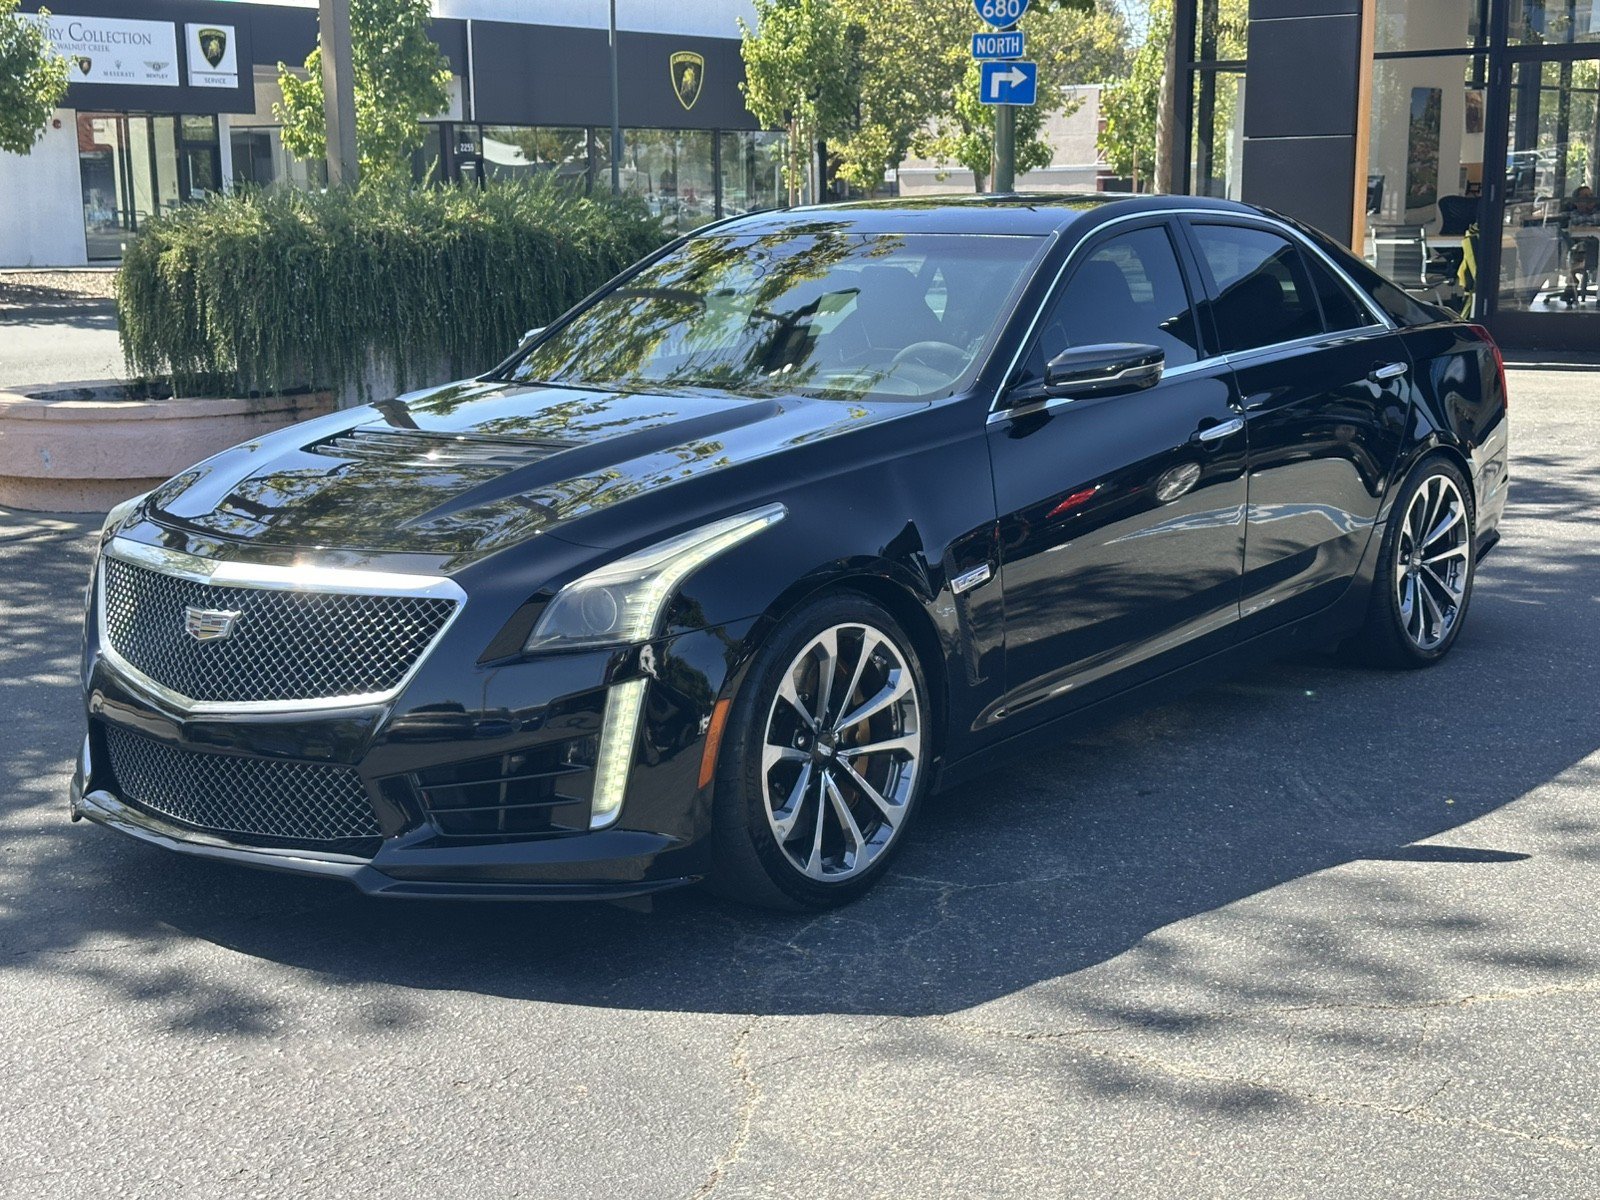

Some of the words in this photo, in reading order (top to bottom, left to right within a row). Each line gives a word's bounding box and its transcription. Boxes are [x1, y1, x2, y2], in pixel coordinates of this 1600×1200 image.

[982, 0, 1020, 18] 680
[68, 22, 152, 45] COLLECTION
[57, 43, 86, 51] WALNUT
[976, 36, 1020, 54] NORTH
